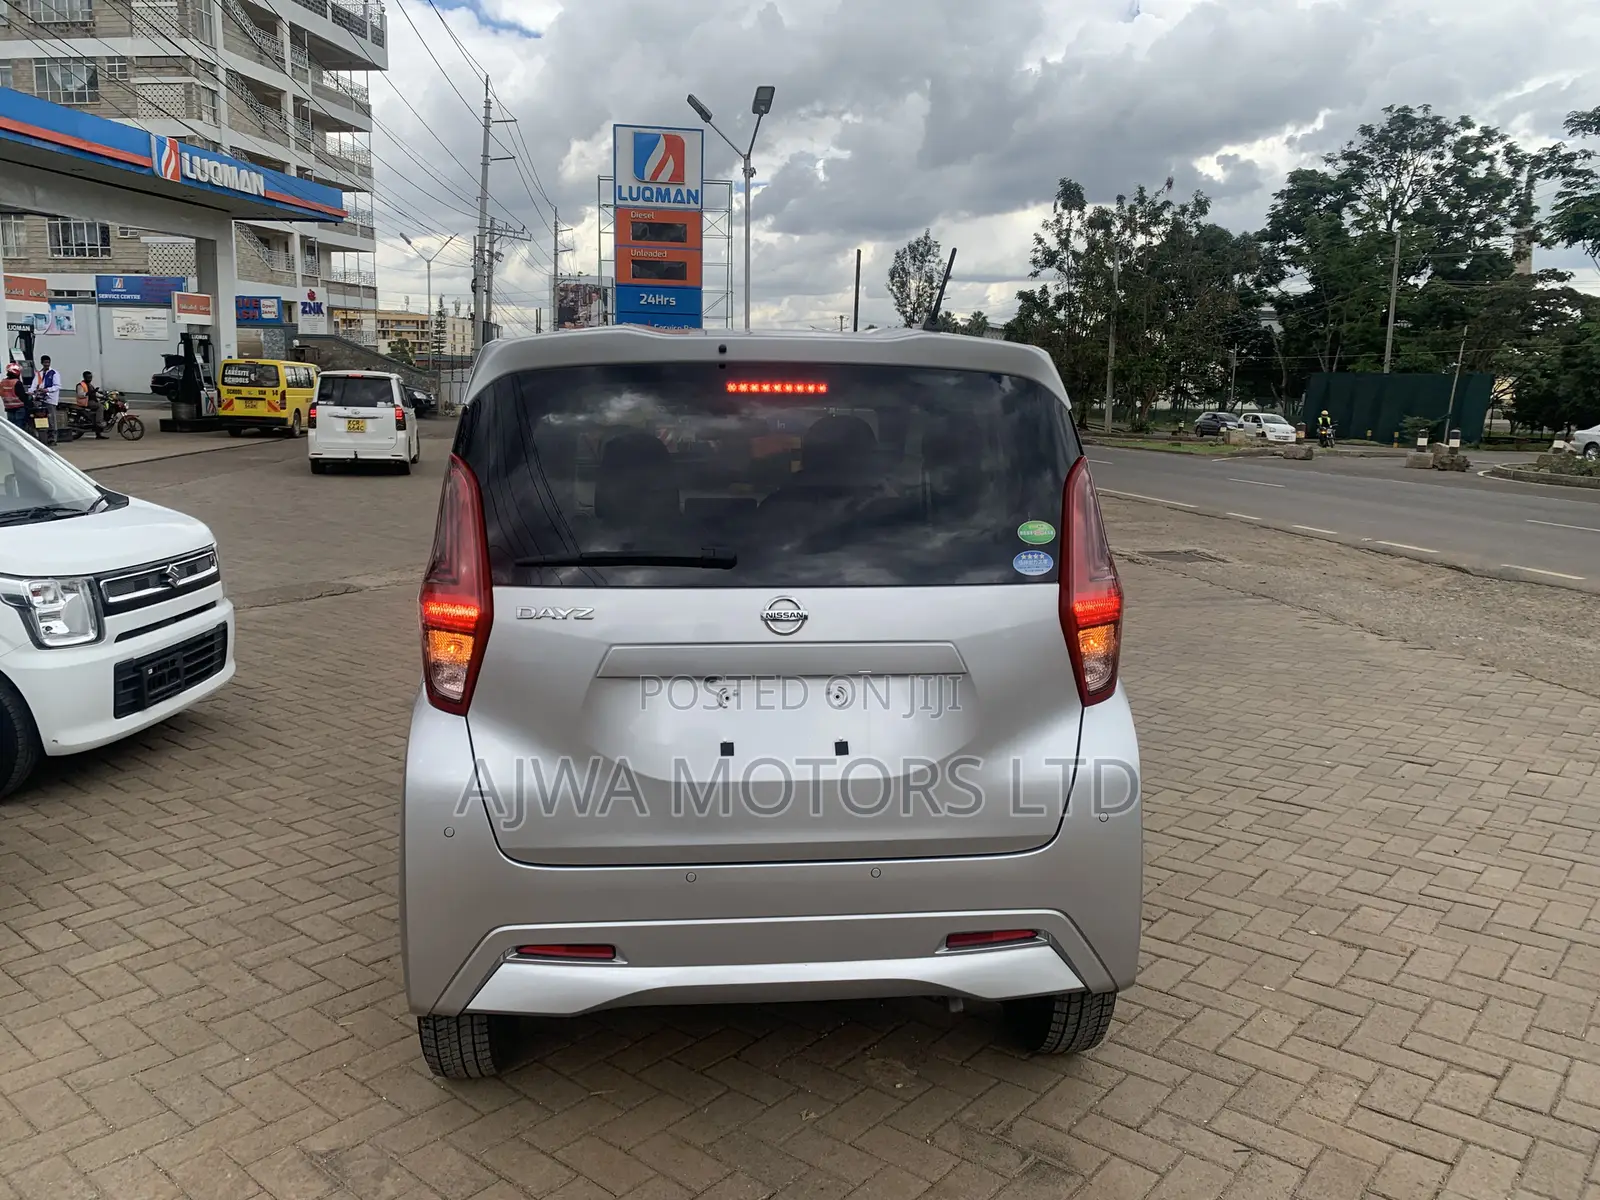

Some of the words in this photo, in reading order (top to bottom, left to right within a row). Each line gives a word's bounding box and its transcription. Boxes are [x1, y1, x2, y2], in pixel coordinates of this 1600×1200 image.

[181, 152, 264, 197] LUQMAN
[618, 185, 699, 205] LUQMAN
[631, 210, 655, 219] Diesel
[631, 249, 667, 258] Unleaded
[640, 293, 676, 306] 24Hrs
[300, 301, 325, 315] ZNK
[516, 605, 595, 621] DAYZ
[765, 611, 804, 620] NISSAN
